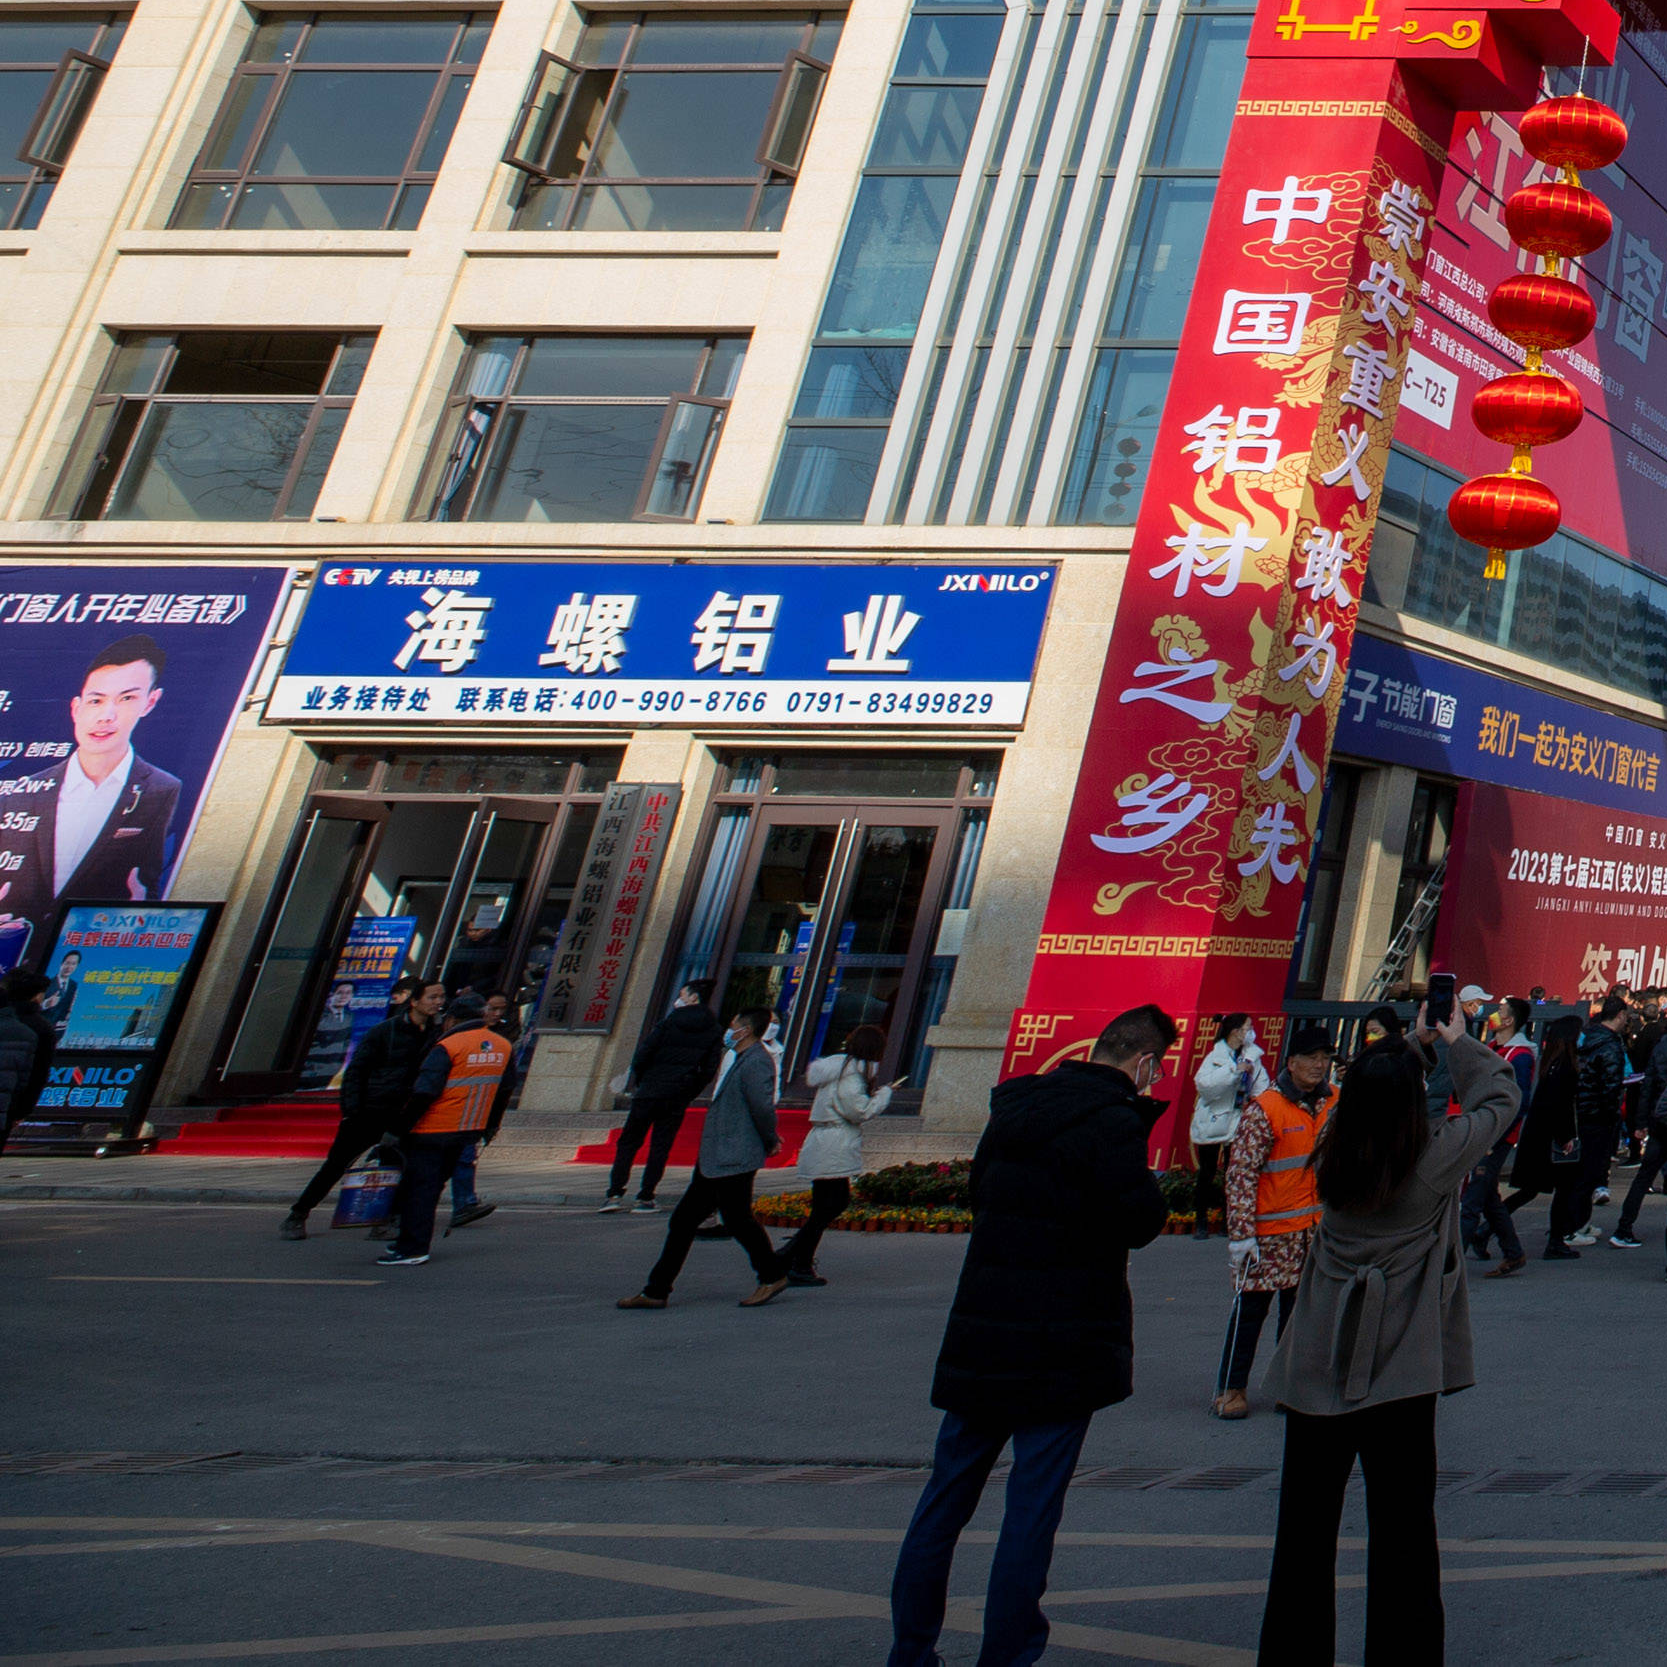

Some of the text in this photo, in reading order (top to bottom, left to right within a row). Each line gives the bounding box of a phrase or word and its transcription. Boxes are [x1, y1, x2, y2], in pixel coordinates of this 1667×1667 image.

[1090, 175, 1333, 854] 中国铝材之乡
[1238, 178, 1425, 885] 崇安重义敢为人先
[324, 568, 383, 586] CCTV
[387, 569, 481, 586] 央视上榜品牌
[393, 587, 925, 676] 海螺铝业
[300, 685, 431, 714] 业务接待处
[786, 691, 994, 715] 0791-83499829
[1340, 668, 1458, 729] 子节能门窗
[24, 742, 74, 758] 创作者
[1478, 705, 1661, 793] 我们一起为安义门窗代言
[1605, 823, 1644, 846] 中国门窗
[547, 790, 633, 1023] 江西海螺铝业有限公司
[583, 792, 669, 1024] 中共江西海螺铝业党支部
[1535, 897, 1570, 912] JIANGXI
[1573, 898, 1593, 913] ANYI
[1595, 900, 1635, 916] ALUMINUM
[1637, 904, 1652, 918] AND
[63, 931, 194, 949] 海螺铝业欢迎您
[36, 1086, 129, 1108] 螺铝业
